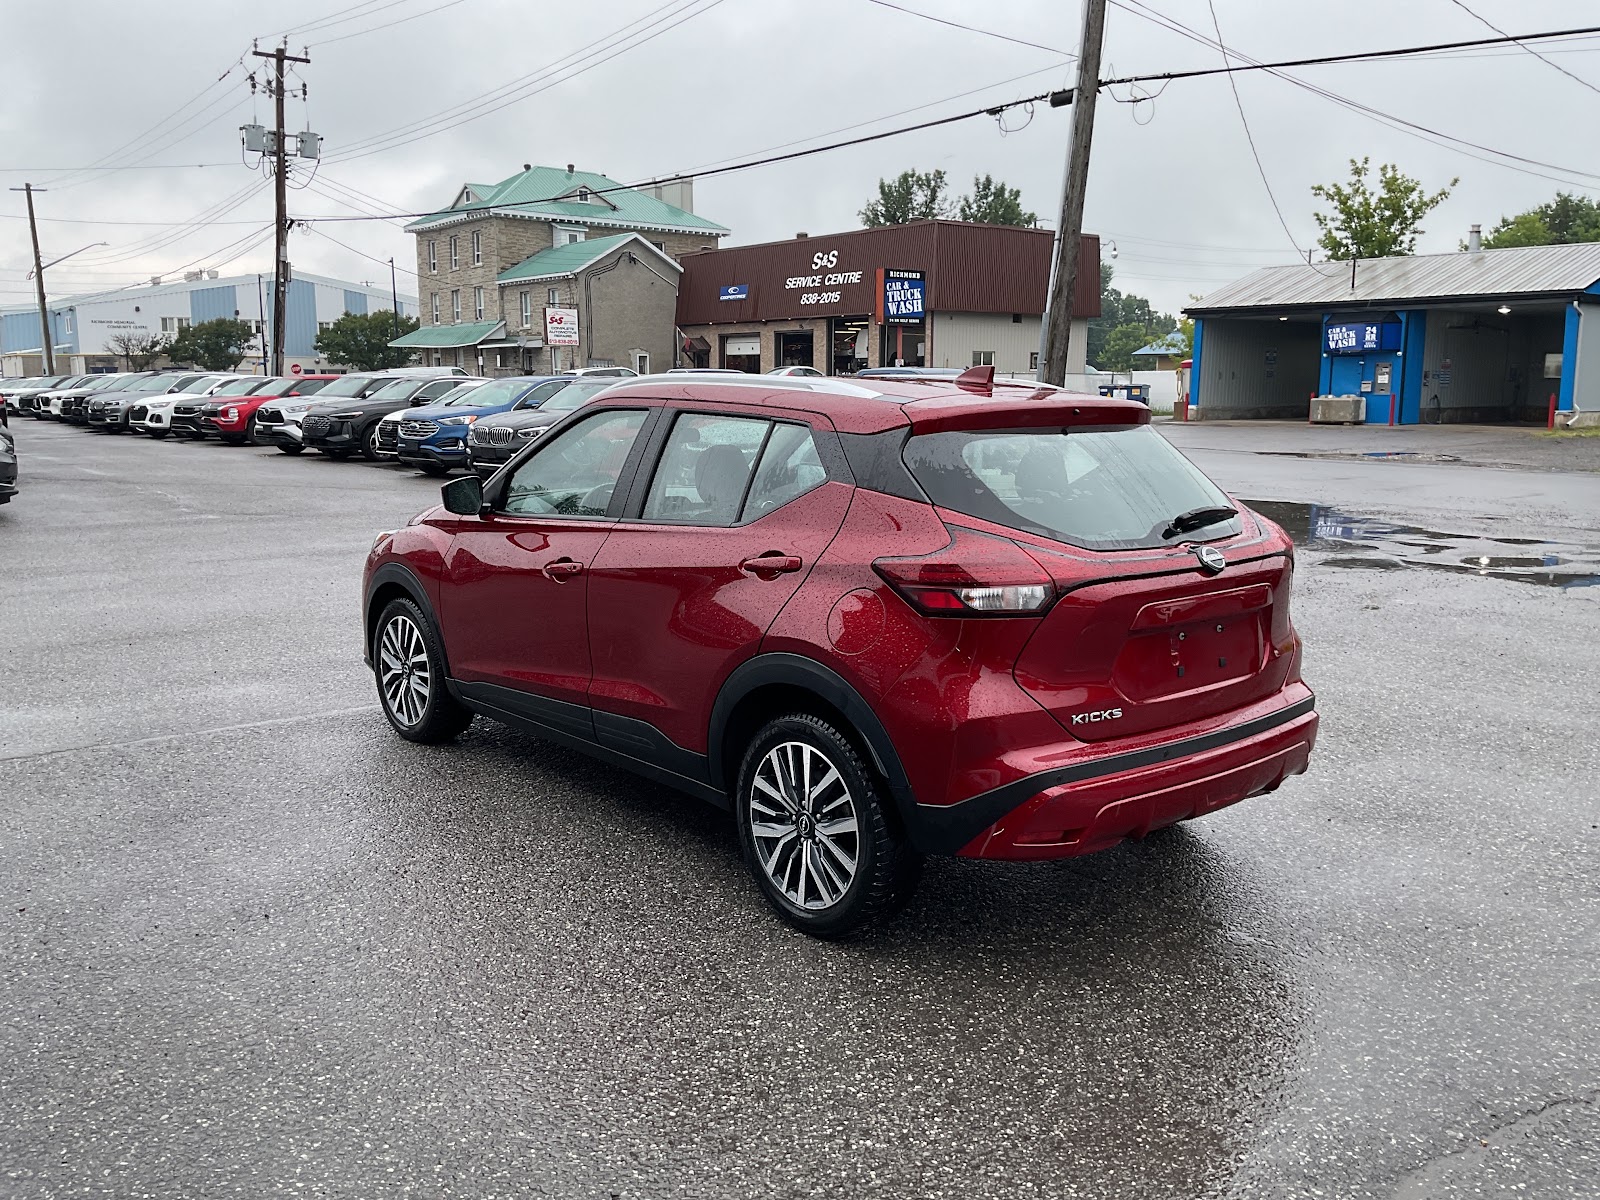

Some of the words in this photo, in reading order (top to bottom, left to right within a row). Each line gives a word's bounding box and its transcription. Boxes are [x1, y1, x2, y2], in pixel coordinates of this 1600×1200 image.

[811, 250, 839, 270] S&S
[785, 275, 822, 290] SERVICE
[824, 271, 863, 286] CENTRE
[889, 270, 921, 279] RICHMOND
[886, 281, 902, 291] CAR
[903, 281, 910, 290] &
[800, 291, 841, 305] 838-2015
[886, 288, 921, 302] TRUCK
[887, 299, 923, 315] WASH
[1327, 327, 1340, 335] CAR
[1328, 331, 1356, 341] TRUCK
[1365, 326, 1377, 334] 24
[1328, 337, 1356, 350] WASH
[1071, 708, 1123, 725] KICKS
